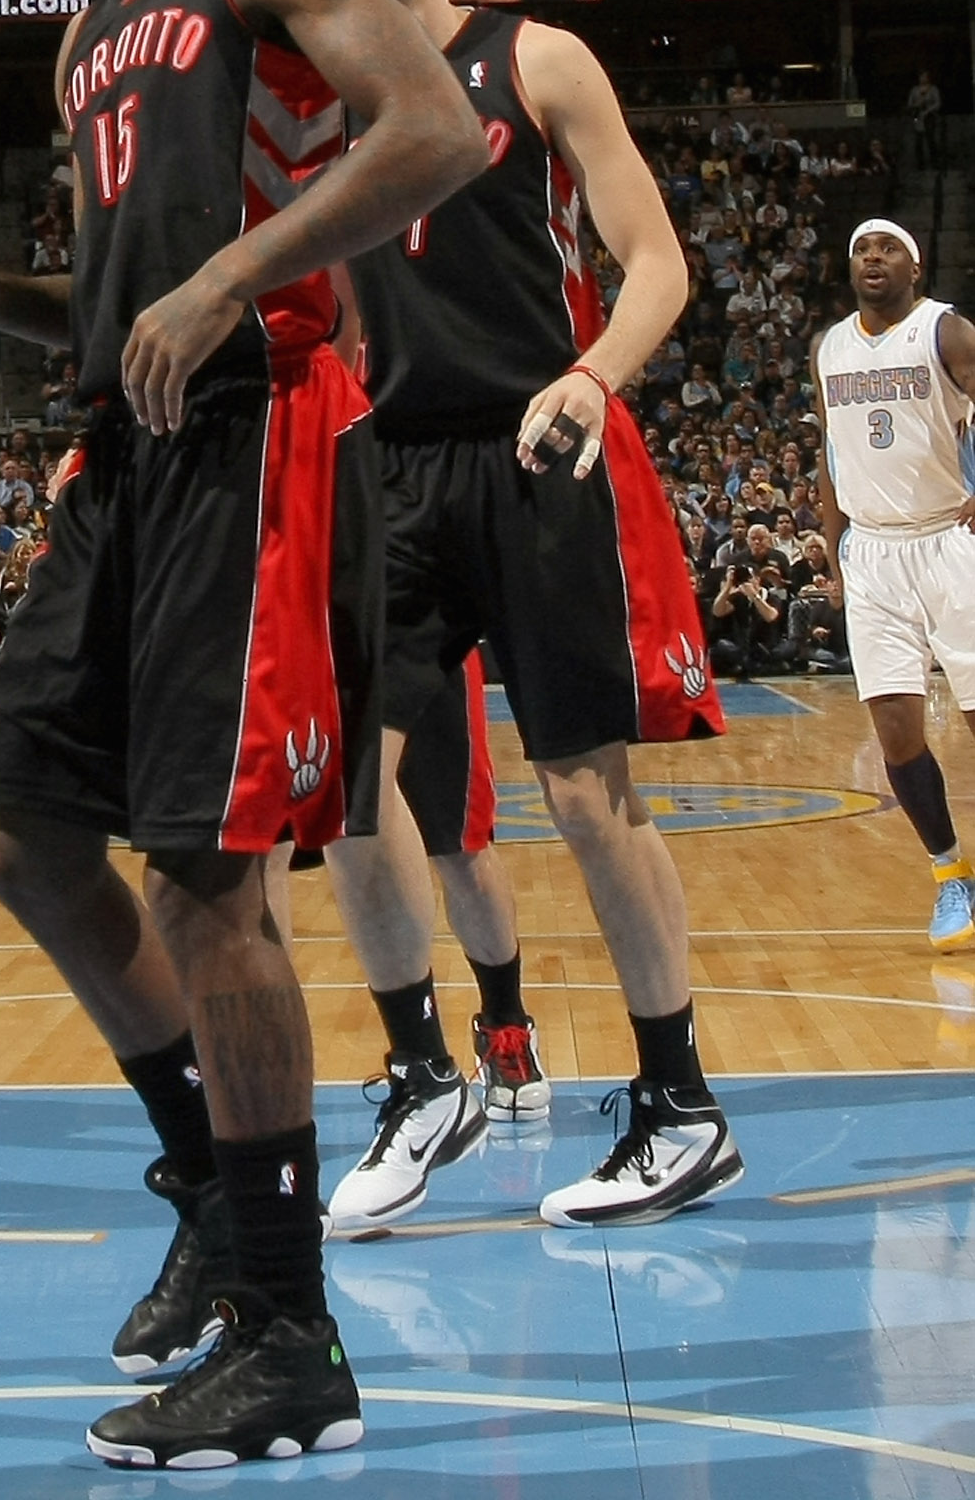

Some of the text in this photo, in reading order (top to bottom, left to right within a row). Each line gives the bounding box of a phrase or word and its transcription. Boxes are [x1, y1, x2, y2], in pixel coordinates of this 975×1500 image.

[64, 6, 213, 133] TORONTO
[92, 89, 142, 210] 15
[826, 365, 932, 409] NUGGETS
[867, 408, 895, 450] 3
